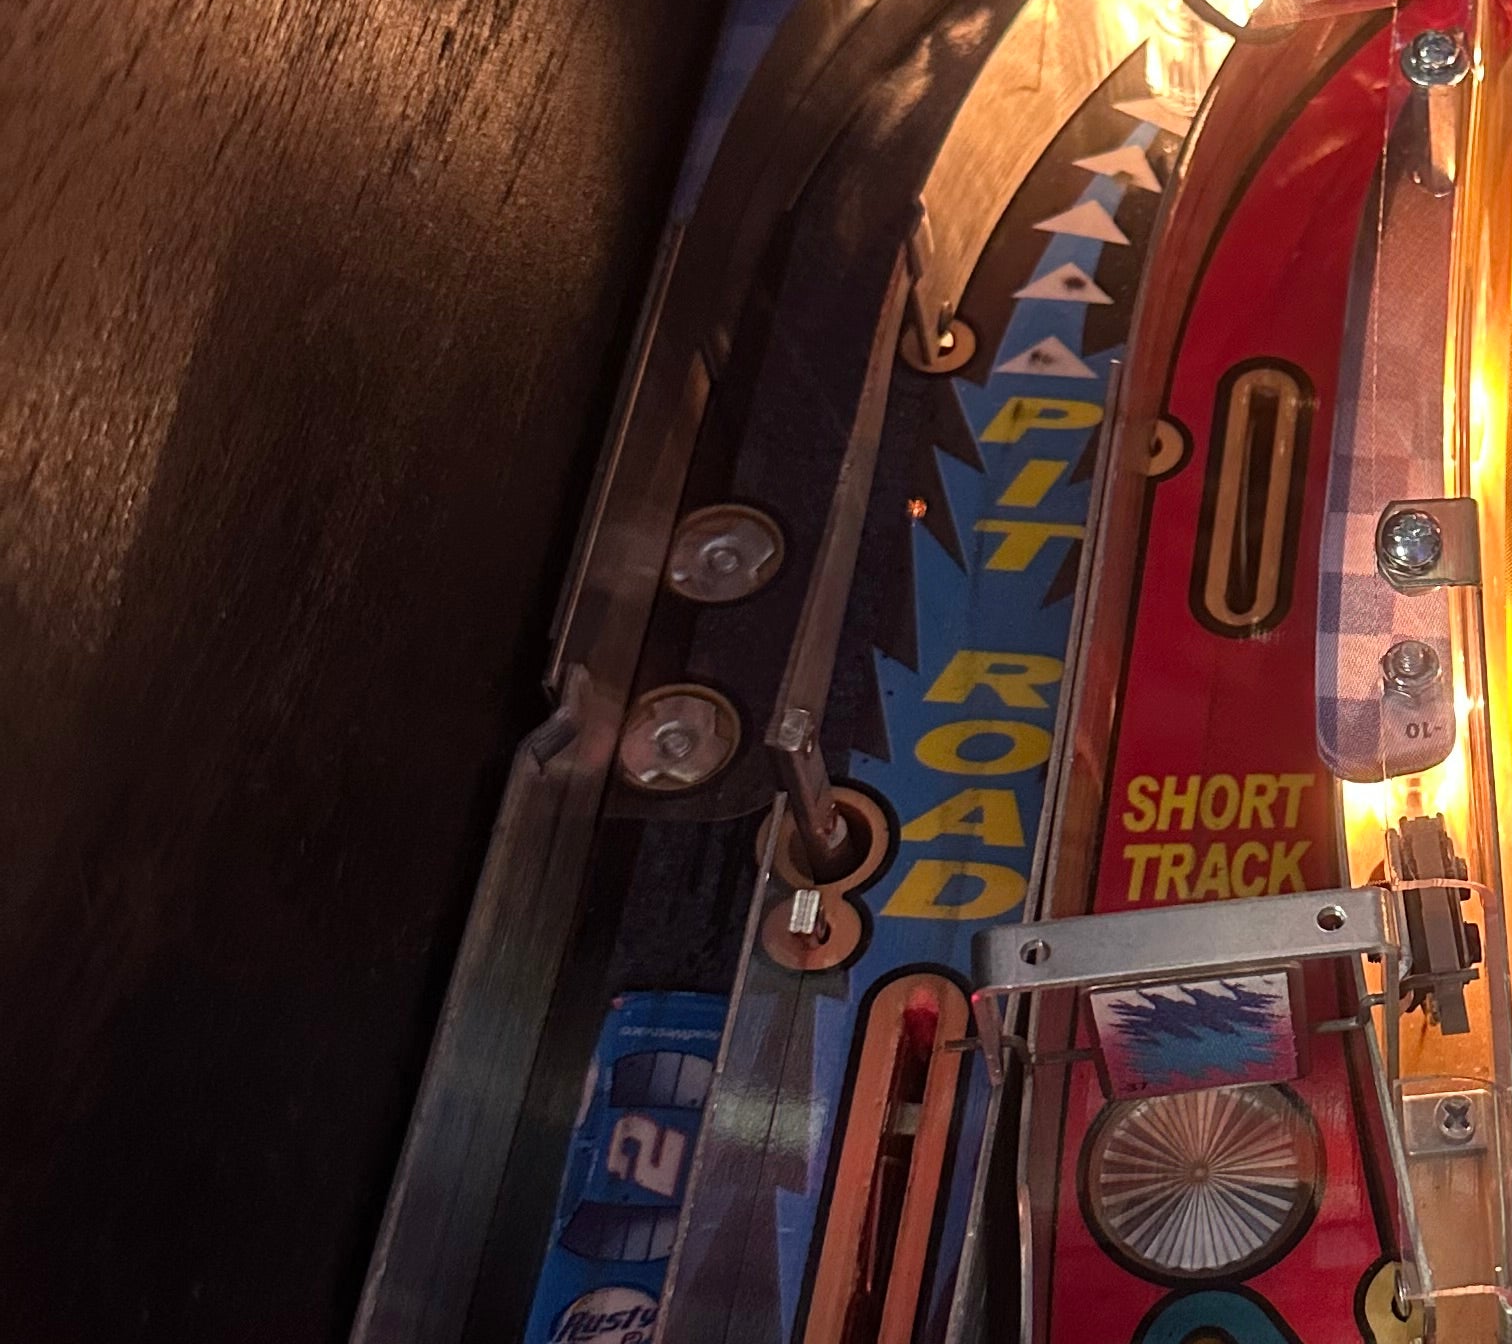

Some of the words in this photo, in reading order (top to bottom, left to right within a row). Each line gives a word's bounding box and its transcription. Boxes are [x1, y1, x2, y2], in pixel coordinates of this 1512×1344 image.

[972, 397, 1104, 572] PIT
[881, 649, 1065, 921] ROAD
[1122, 773, 1316, 833] SHORT
[1123, 840, 1313, 902] TRACK
[607, 1113, 687, 1197] 2
[553, 1303, 660, 1344] Rusty
